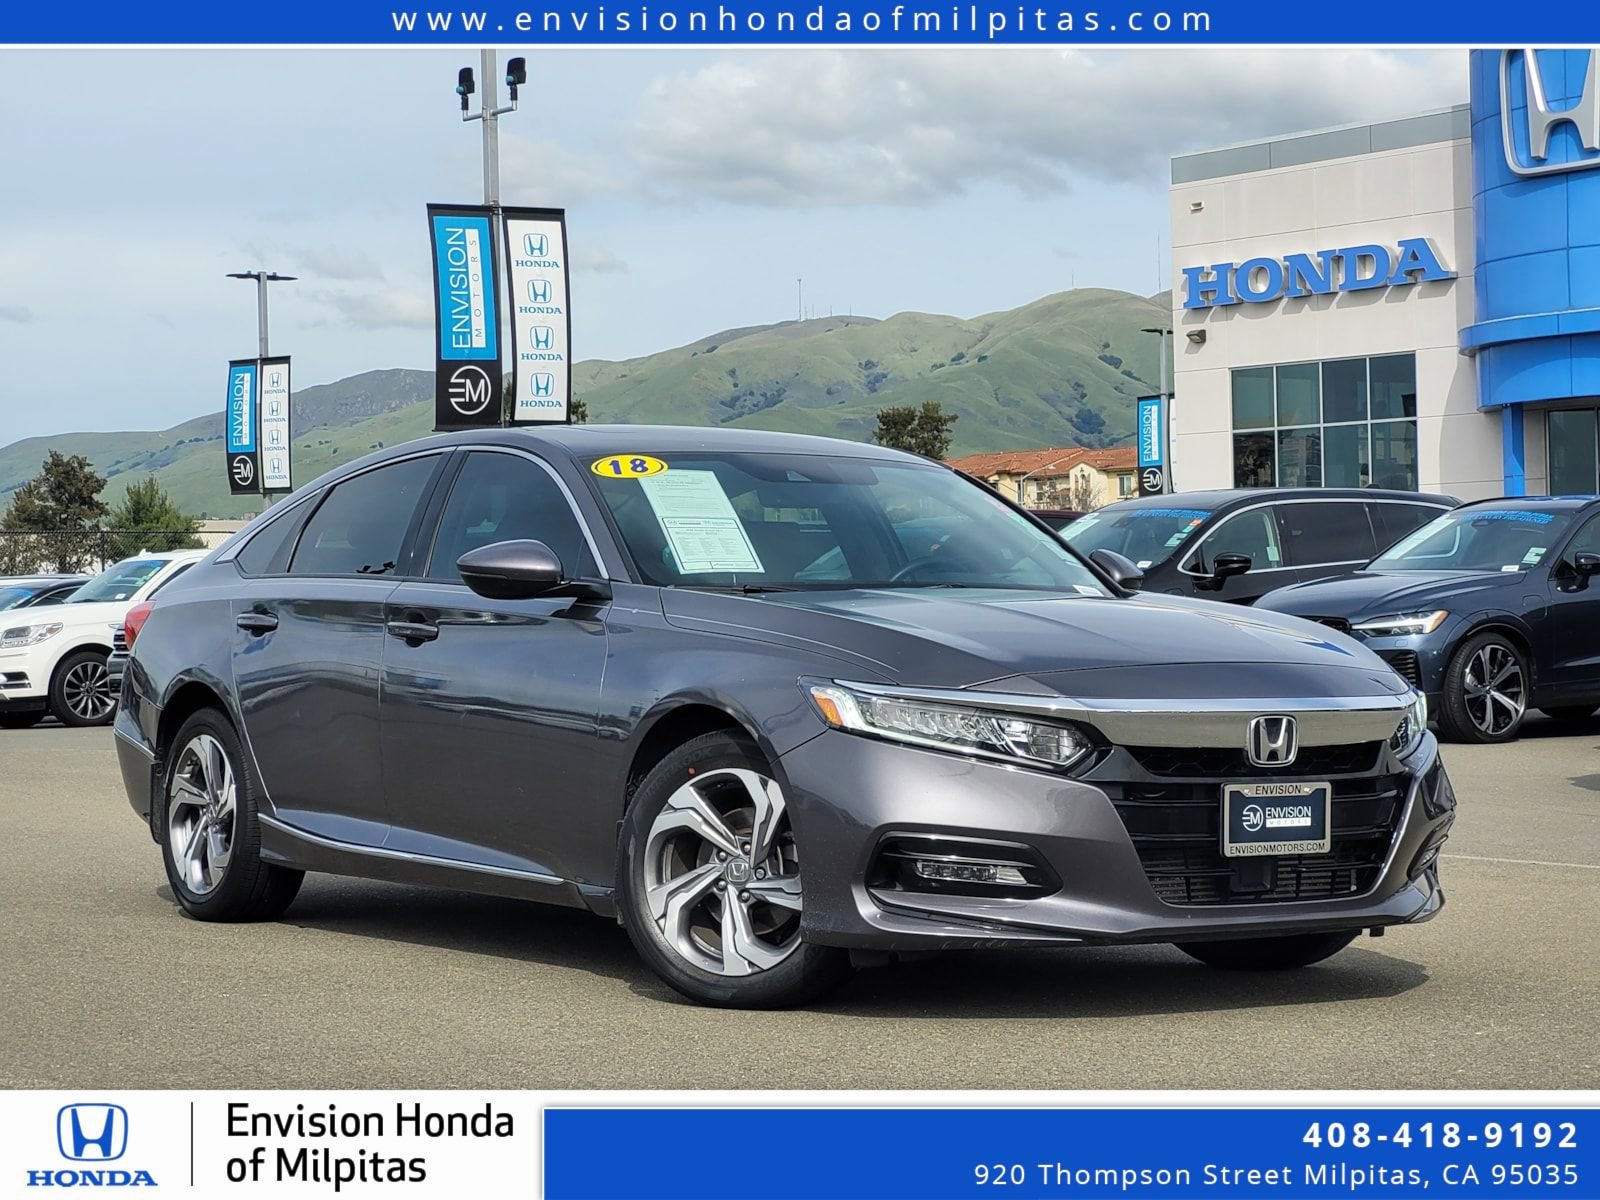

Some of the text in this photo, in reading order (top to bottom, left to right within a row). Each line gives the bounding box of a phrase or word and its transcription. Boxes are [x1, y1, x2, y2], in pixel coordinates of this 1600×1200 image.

[515, 259, 560, 268] HONDA
[1182, 237, 1458, 309] HONDA
[445, 228, 471, 348] ENVISION
[469, 239, 483, 338] MOTORS
[519, 306, 562, 315] HONDA
[521, 352, 563, 361] HONDA
[520, 399, 562, 408] HONDA
[233, 373, 245, 446] ENVISION
[1143, 405, 1152, 462] ENVISION
[1255, 785, 1301, 795] ENVISION
[1266, 806, 1311, 818] ENVISION
[1230, 843, 1325, 854] ENVISIONMOTORS.COM
